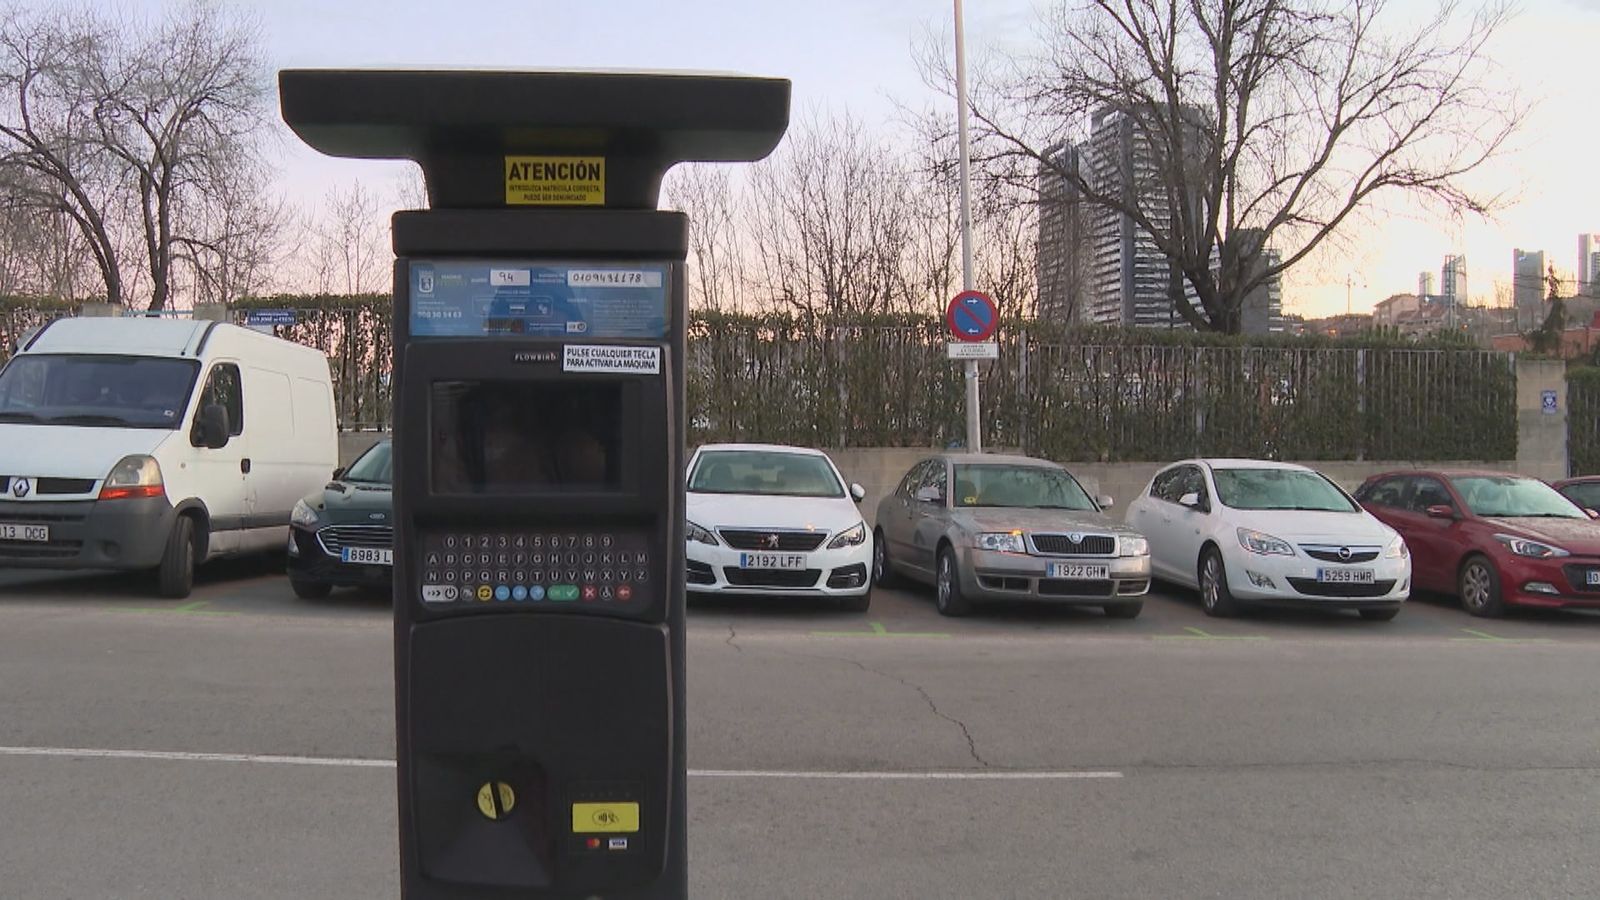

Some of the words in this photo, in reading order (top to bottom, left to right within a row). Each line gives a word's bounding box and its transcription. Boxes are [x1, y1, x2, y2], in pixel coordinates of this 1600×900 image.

[508, 160, 600, 181] ATENCIÓN
[499, 271, 514, 283] 94
[566, 348, 590, 358] PULSE
[591, 349, 632, 360] CUALQUIER
[633, 350, 656, 360] TECLA
[566, 358, 585, 367] PARA
[585, 359, 613, 368] ACTIVAR
[613, 360, 623, 368] LA
[0, 526, 16, 538] 13
[447, 537, 454, 547] 0
[465, 537, 470, 547] 1
[482, 537, 488, 547] 2
[500, 537, 506, 547] 3
[516, 537, 523, 547] 4
[534, 537, 541, 547] 5
[551, 537, 558, 547] 6
[569, 537, 575, 547] 7
[586, 537, 593, 547] 8
[603, 537, 610, 547] 9
[351, 550, 380, 561] 8983
[429, 554, 437, 563] A
[447, 554, 454, 563] B
[464, 554, 472, 563] C
[482, 554, 489, 563] D
[500, 554, 506, 563] E
[517, 554, 523, 563] F
[533, 554, 541, 563] G
[551, 554, 559, 563] H
[586, 554, 593, 563] J
[603, 554, 610, 563] K
[621, 554, 627, 563] L
[637, 554, 646, 563] M
[748, 555, 776, 567] 2192
[780, 556, 803, 568] LFF
[429, 572, 437, 580] N
[446, 572, 455, 580] O
[464, 572, 472, 580] P
[499, 572, 507, 580] R
[516, 572, 524, 580] S
[534, 572, 541, 580] T
[552, 572, 558, 580] U
[569, 572, 576, 580] V
[584, 572, 595, 580] W
[604, 572, 610, 580] X
[621, 572, 628, 580] Y
[638, 572, 645, 580] Z
[1058, 564, 1083, 577] 1922
[1325, 569, 1350, 581] 5259
